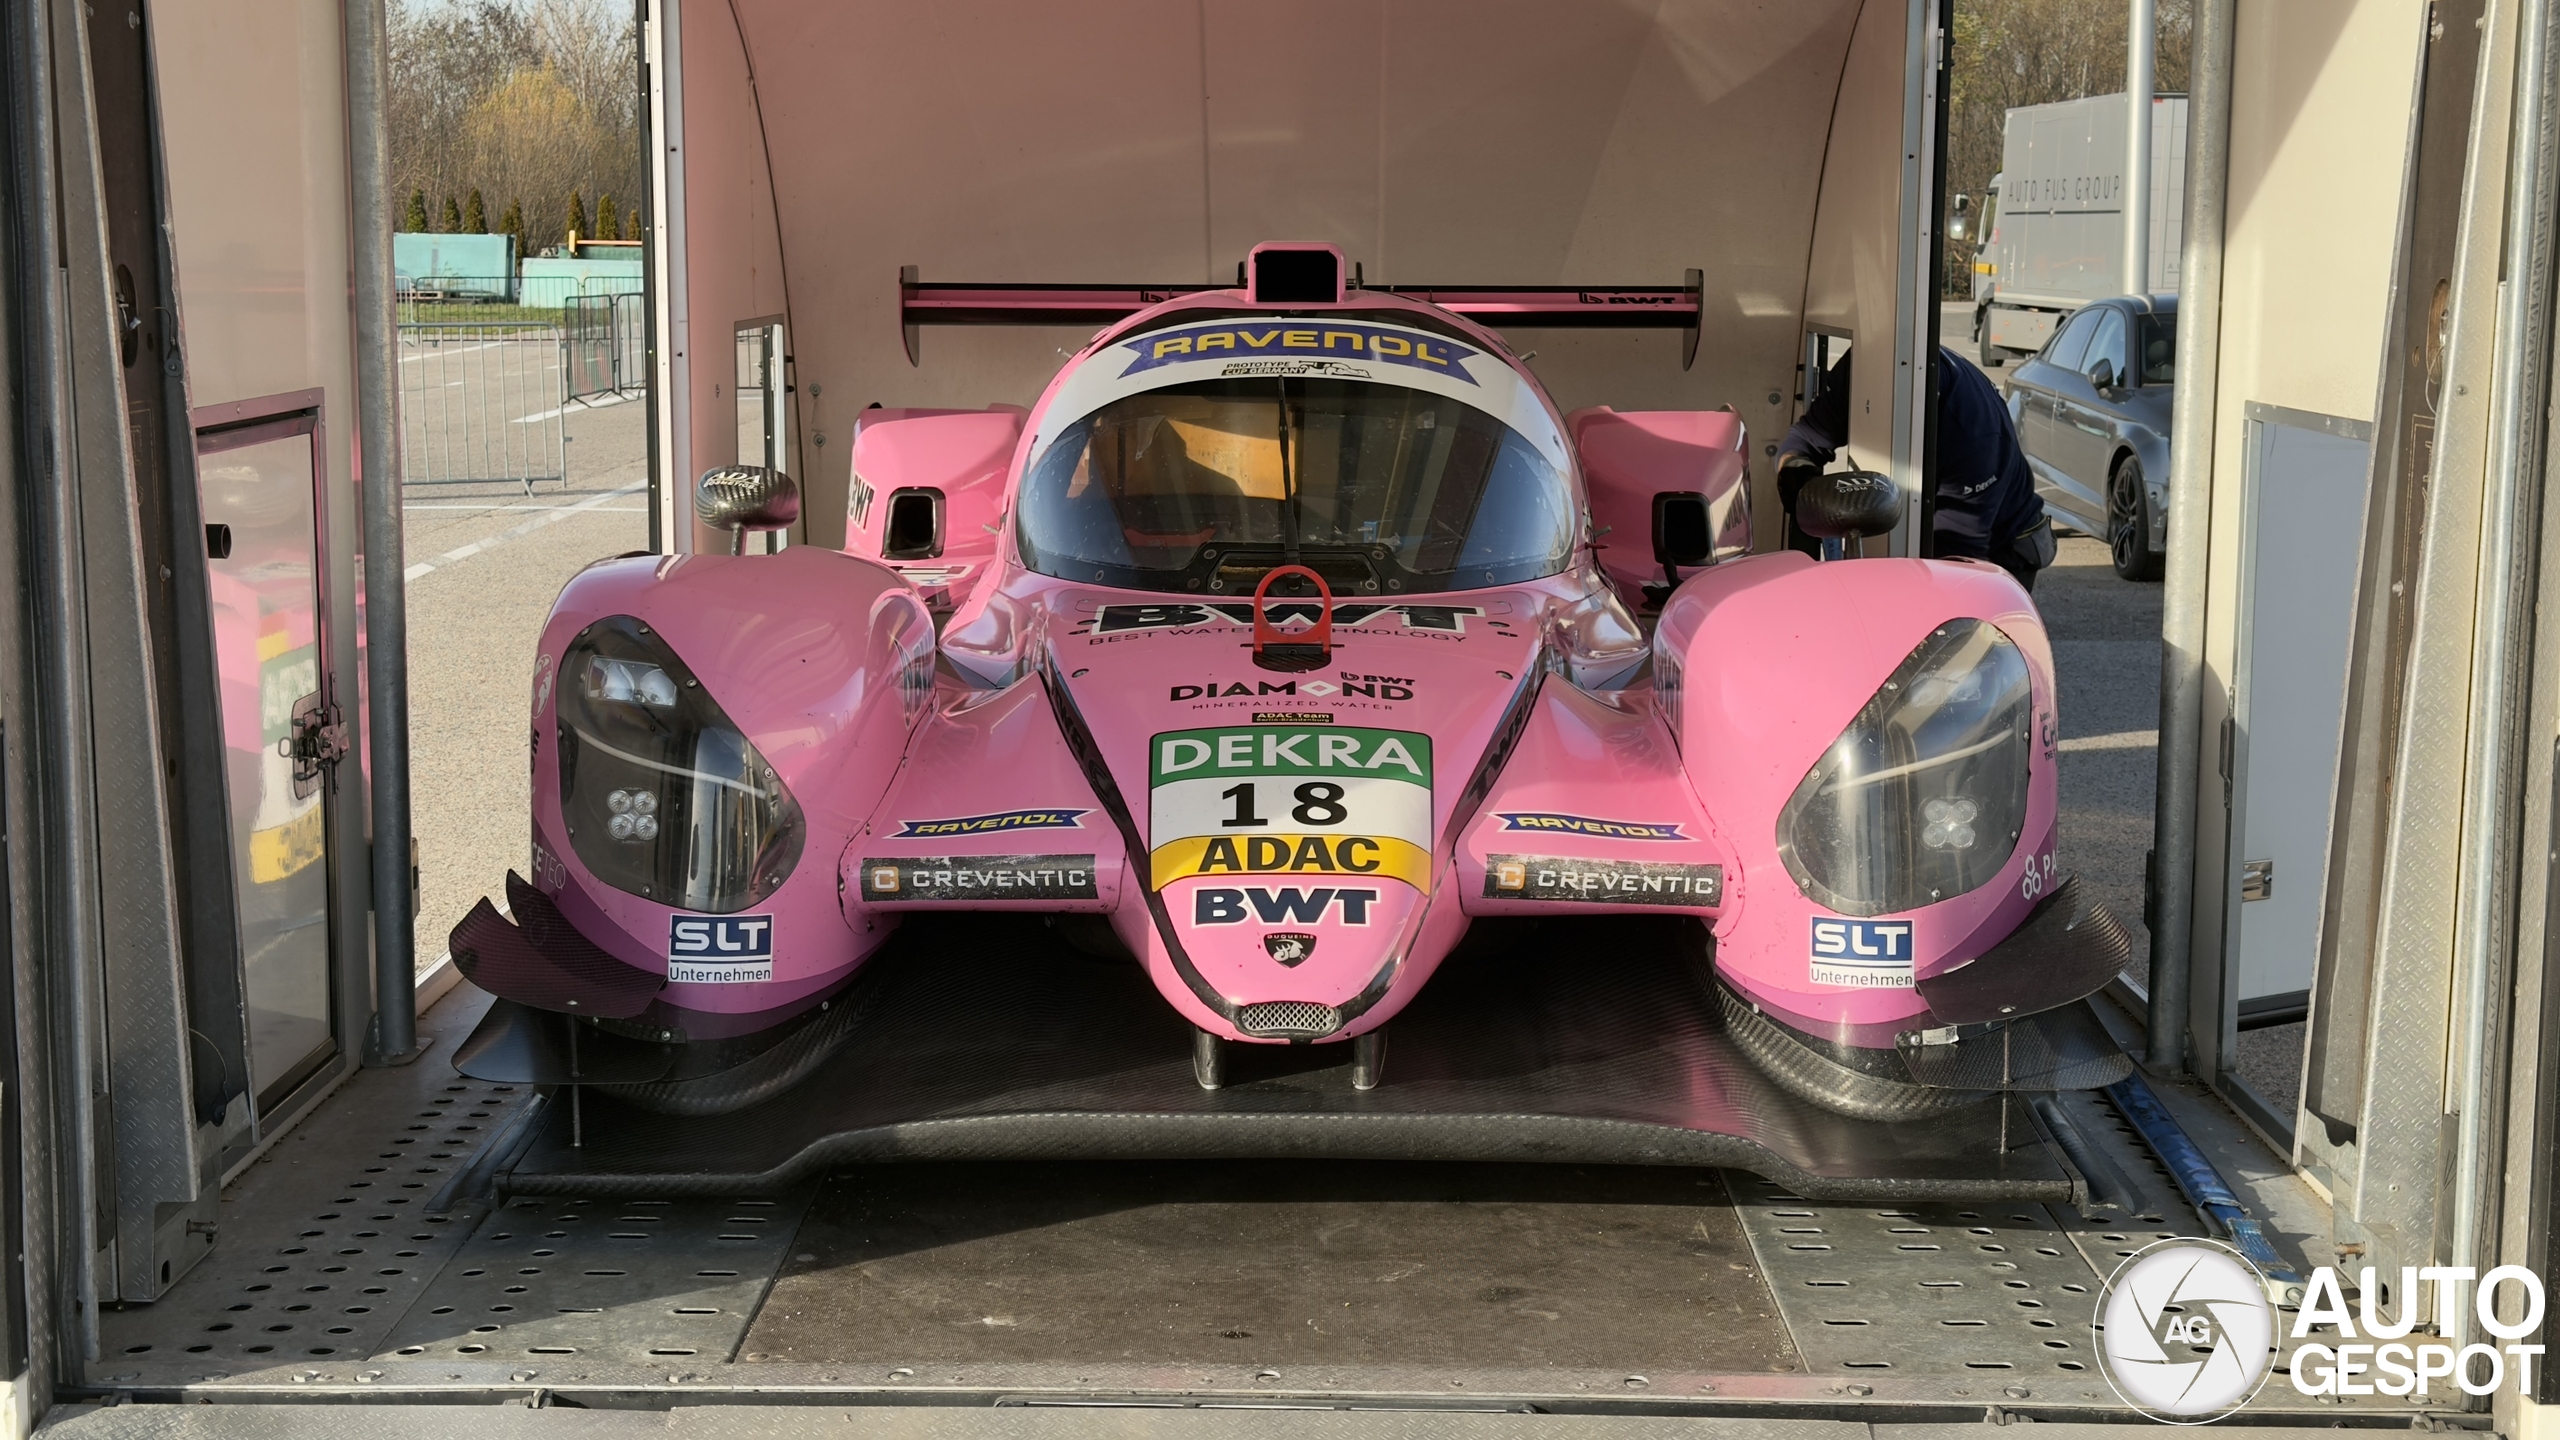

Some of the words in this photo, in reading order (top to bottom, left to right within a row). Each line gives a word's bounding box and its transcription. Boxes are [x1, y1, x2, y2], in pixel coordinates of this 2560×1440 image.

[2008, 180, 2038, 203] AUTO
[2045, 178, 2066, 201] FUS
[2075, 175, 2120, 200] GROUP
[1835, 478, 1890, 488] ADA
[1096, 603, 1481, 633] BWT
[1089, 631, 1158, 646] BEST
[1275, 626, 1467, 643] TEHNOLOGY
[1363, 675, 1416, 686] BWT
[1192, 700, 1319, 710] MINERALIZED
[1331, 701, 1393, 711] WATER
[1160, 734, 1424, 777] DEKRA
[1198, 836, 1381, 873] ADAC
[912, 869, 1087, 888] CREVENTIC
[1537, 869, 1714, 895] CREVENTIC
[1195, 888, 1378, 926] BWT
[675, 921, 768, 951] SLT
[1815, 923, 1908, 956] SLT
[670, 966, 771, 982] Unternehmen
[1811, 968, 1913, 986] Unternehmen
